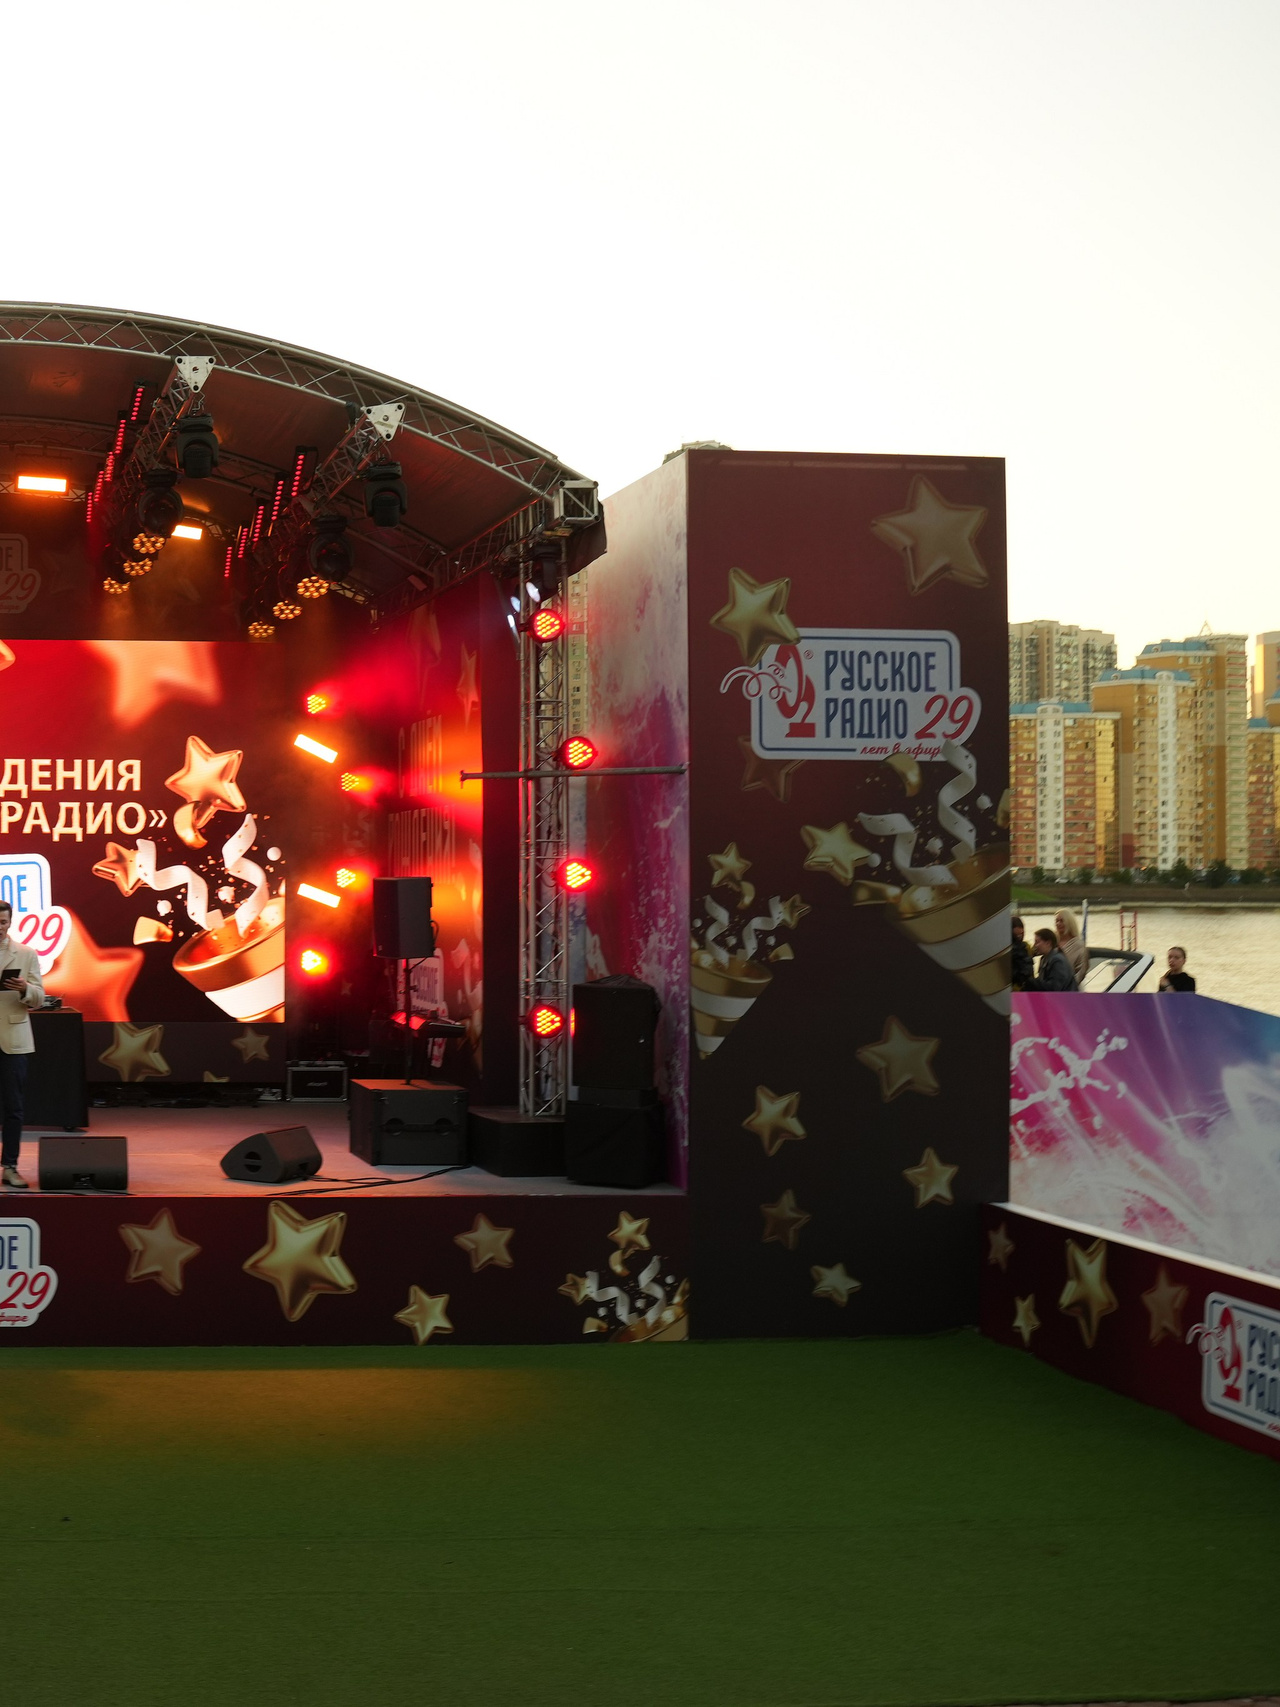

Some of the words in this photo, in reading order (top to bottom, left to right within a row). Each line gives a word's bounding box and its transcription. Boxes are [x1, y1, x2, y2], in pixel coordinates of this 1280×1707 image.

[823, 649, 937, 693] РУССКОЕ
[823, 696, 909, 740] РАДИО
[914, 694, 975, 741] 29
[859, 743, 890, 756] лет
[904, 742, 941, 763] эфир
[0, 800, 169, 843] РАДИО»
[18, 913, 64, 957] 29
